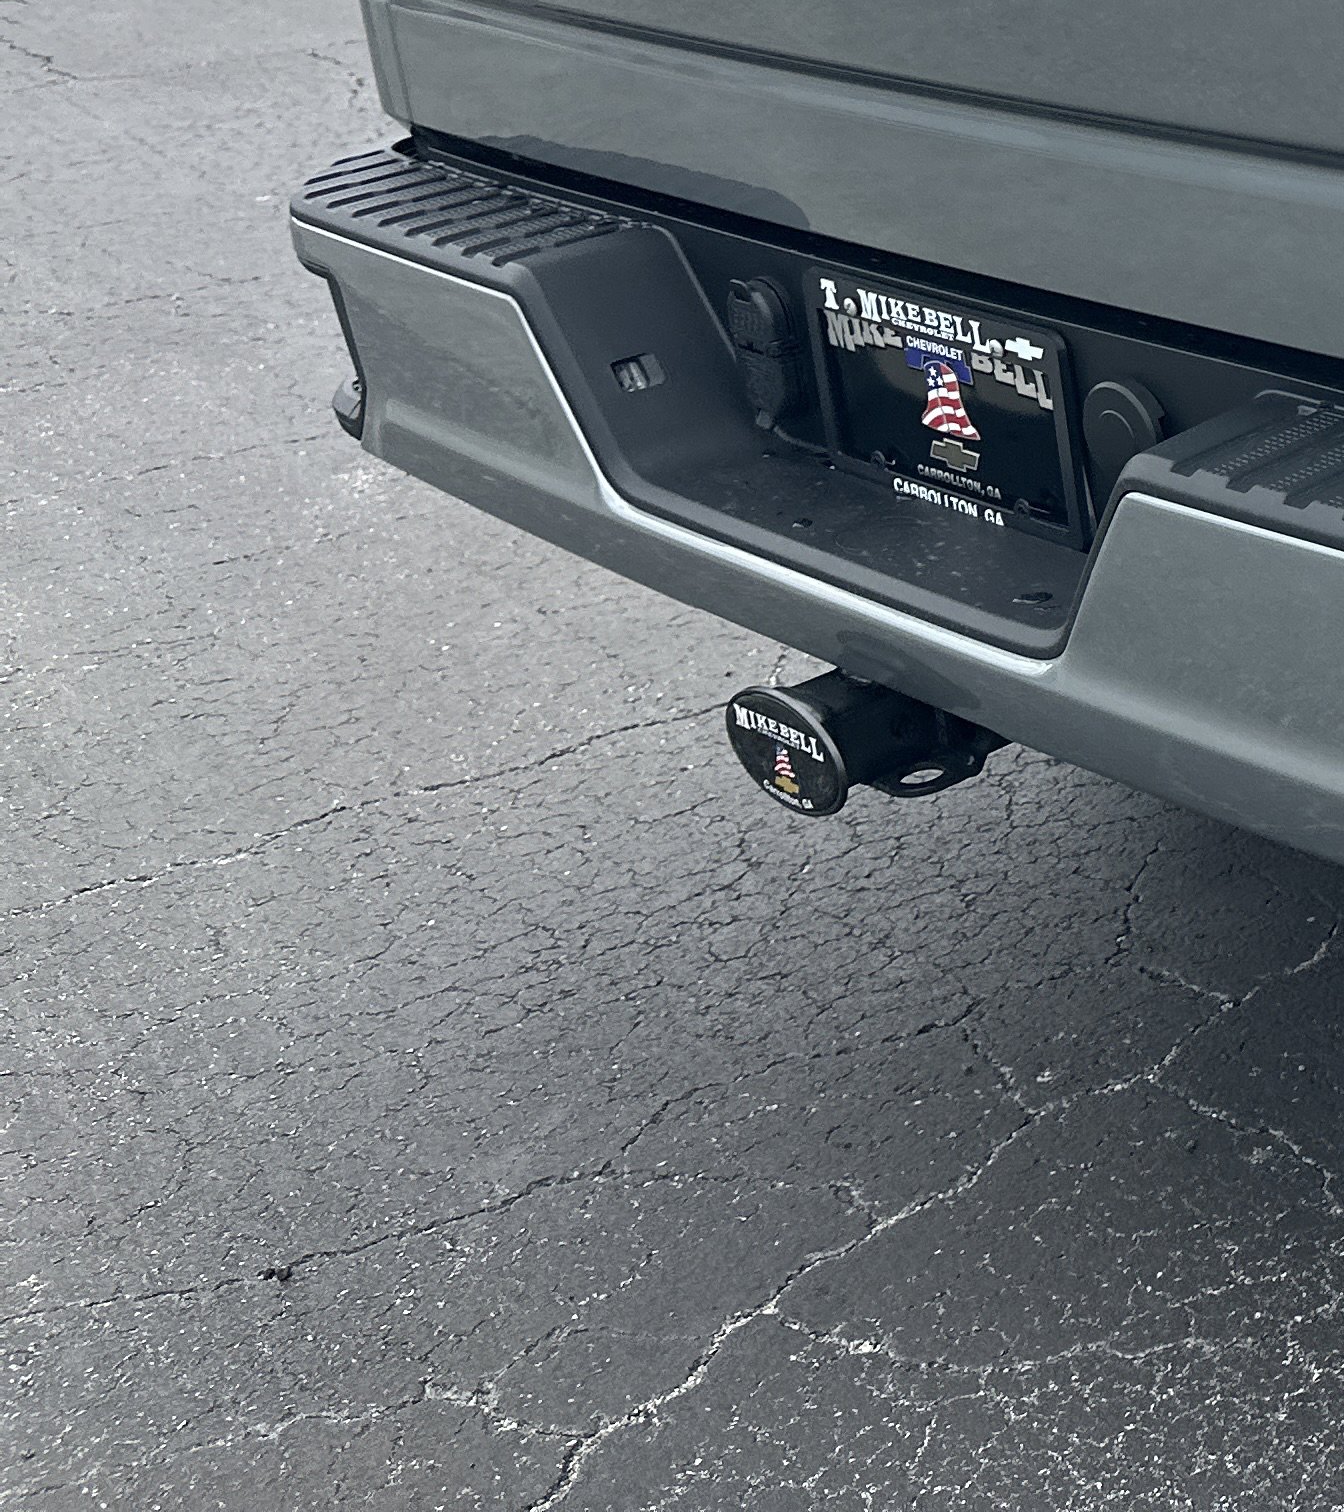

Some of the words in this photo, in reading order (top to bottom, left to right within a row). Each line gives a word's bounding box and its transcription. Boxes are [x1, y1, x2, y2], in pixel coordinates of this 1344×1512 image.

[856, 289, 920, 322] MIKE
[922, 306, 991, 354] BELL
[906, 334, 965, 361] CHEVROLET
[733, 702, 779, 734] MIKE
